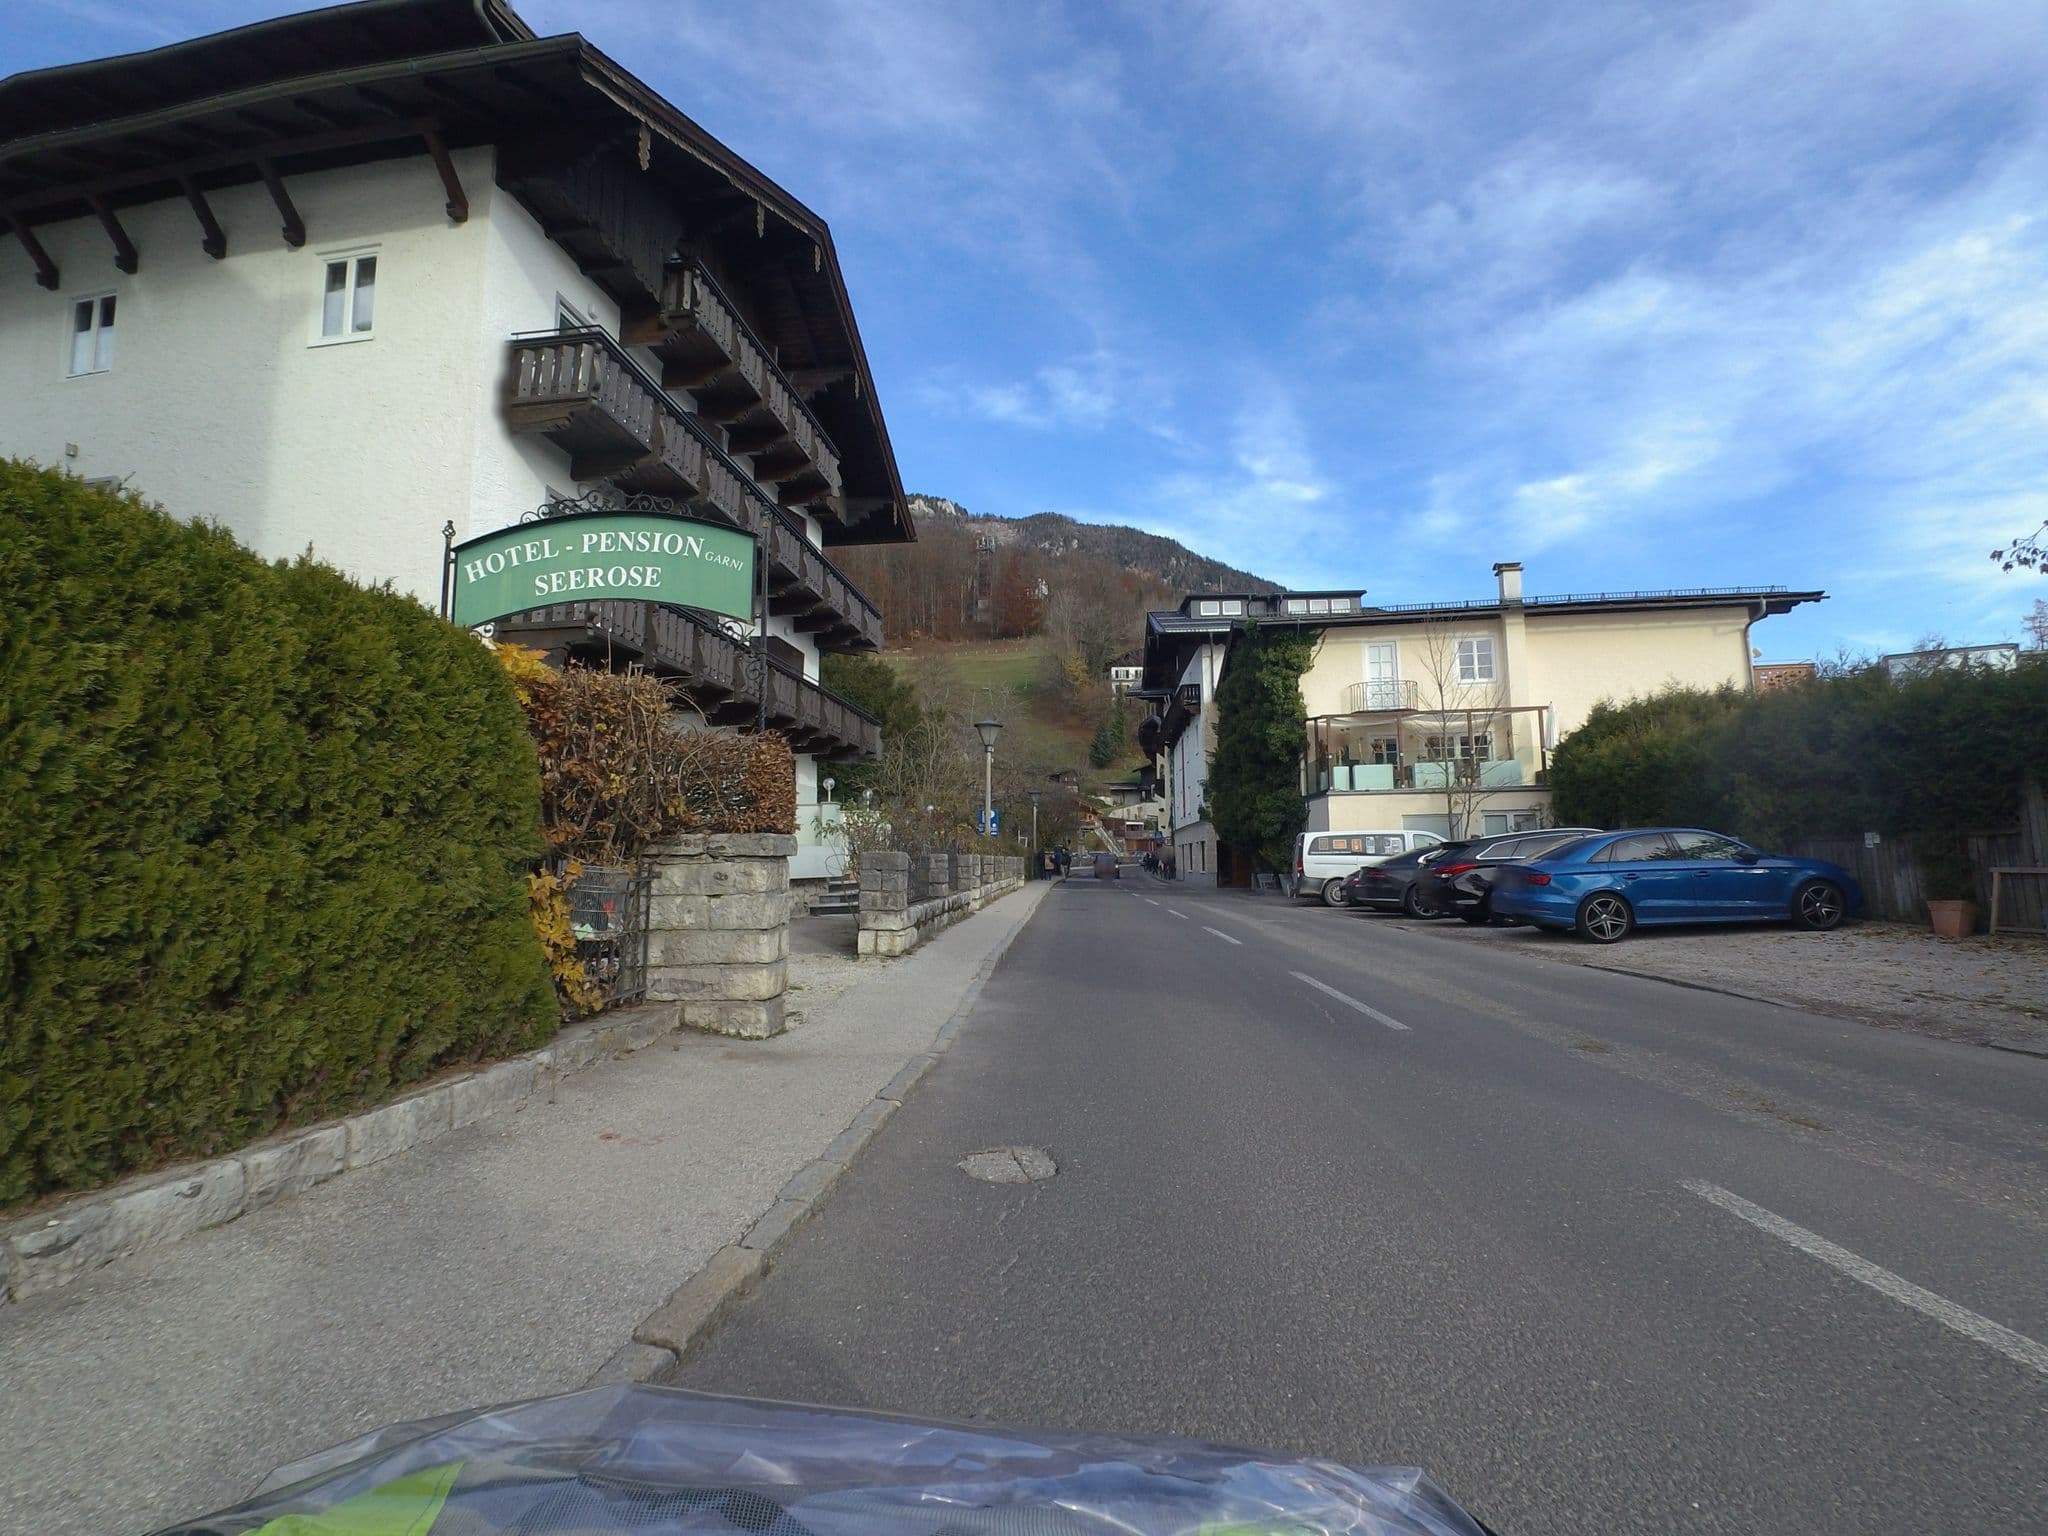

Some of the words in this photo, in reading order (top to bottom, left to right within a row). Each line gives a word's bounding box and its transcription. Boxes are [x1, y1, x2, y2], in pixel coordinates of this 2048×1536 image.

[464, 538, 559, 584] HOTEL
[581, 531, 705, 559] PENSION
[704, 551, 744, 572] GARNI
[534, 565, 662, 597] SEEROSE
